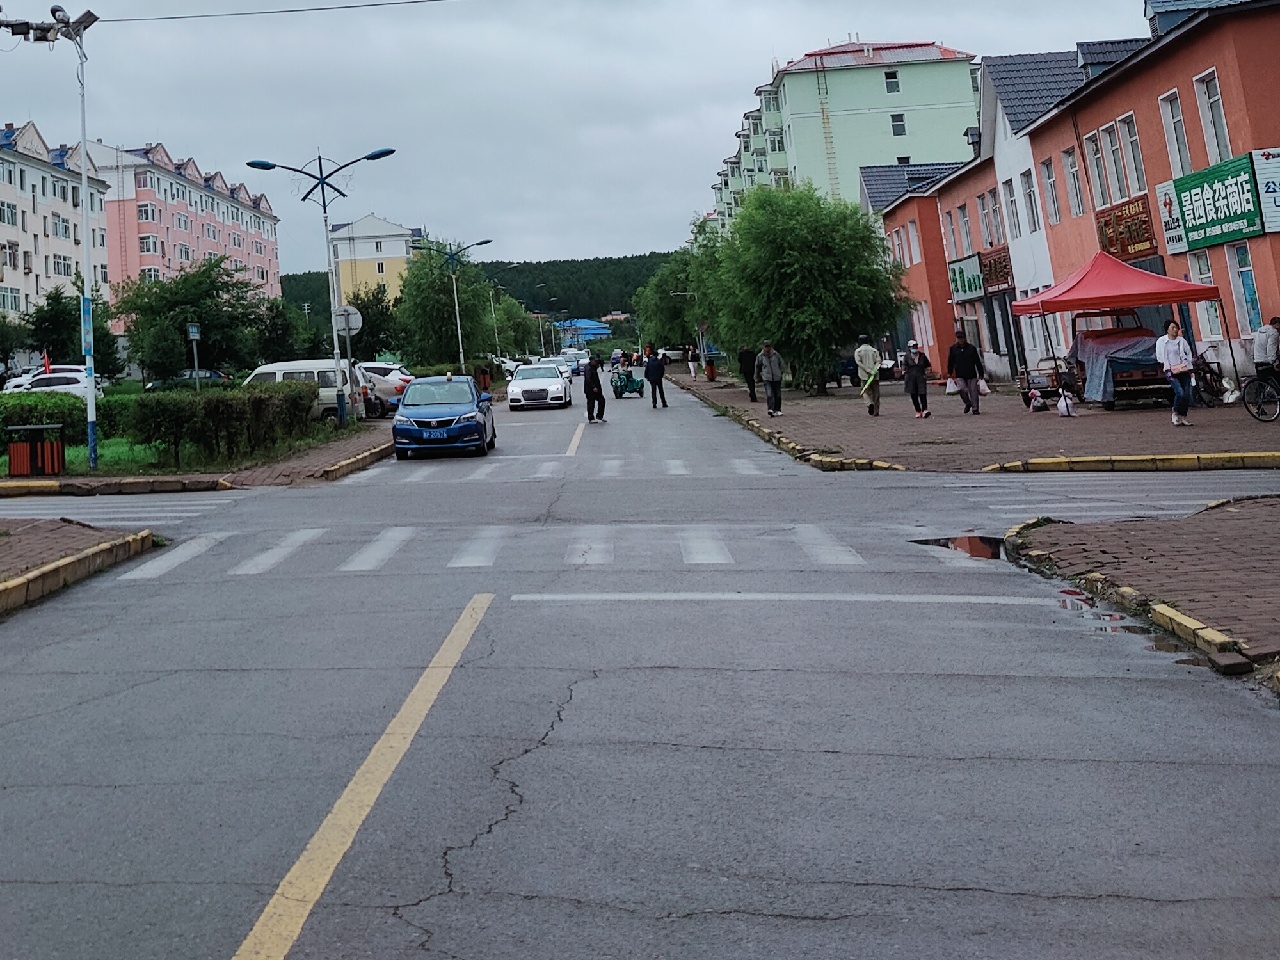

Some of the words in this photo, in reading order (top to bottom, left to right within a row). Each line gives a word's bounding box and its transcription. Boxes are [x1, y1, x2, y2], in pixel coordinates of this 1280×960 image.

[1181, 172, 1255, 228] 景园食杂商店
